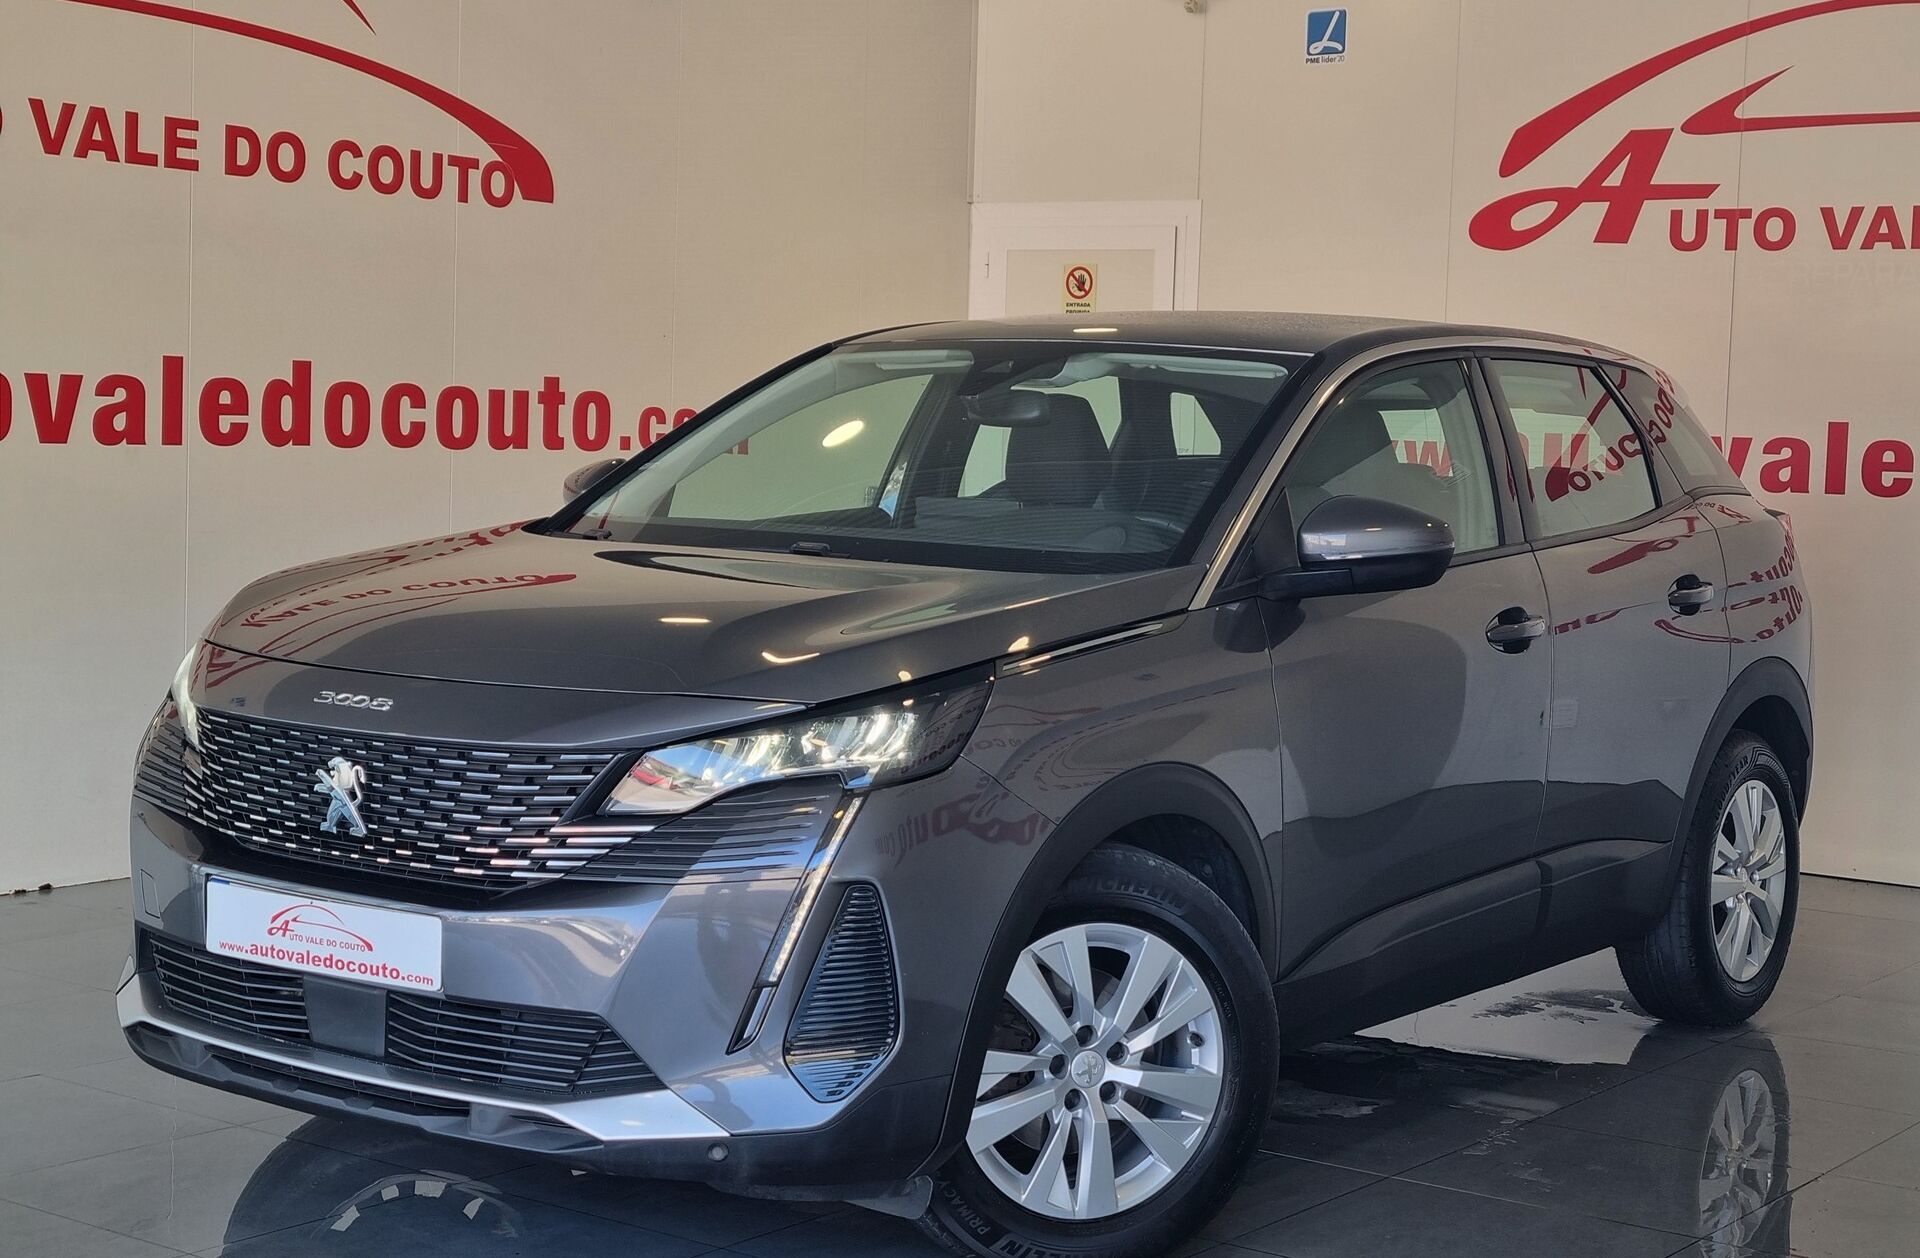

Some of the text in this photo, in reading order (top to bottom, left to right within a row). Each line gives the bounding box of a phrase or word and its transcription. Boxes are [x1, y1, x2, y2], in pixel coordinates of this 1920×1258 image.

[28, 97, 516, 208] VALE DO COUTO
[1820, 206, 1920, 250] VA
[313, 690, 394, 712] 3008
[267, 919, 366, 953] AUTO VALE DO COUTO
[219, 939, 434, 987] www.autovaledocouto.com
[937, 1179, 992, 1236] PRIMACY
